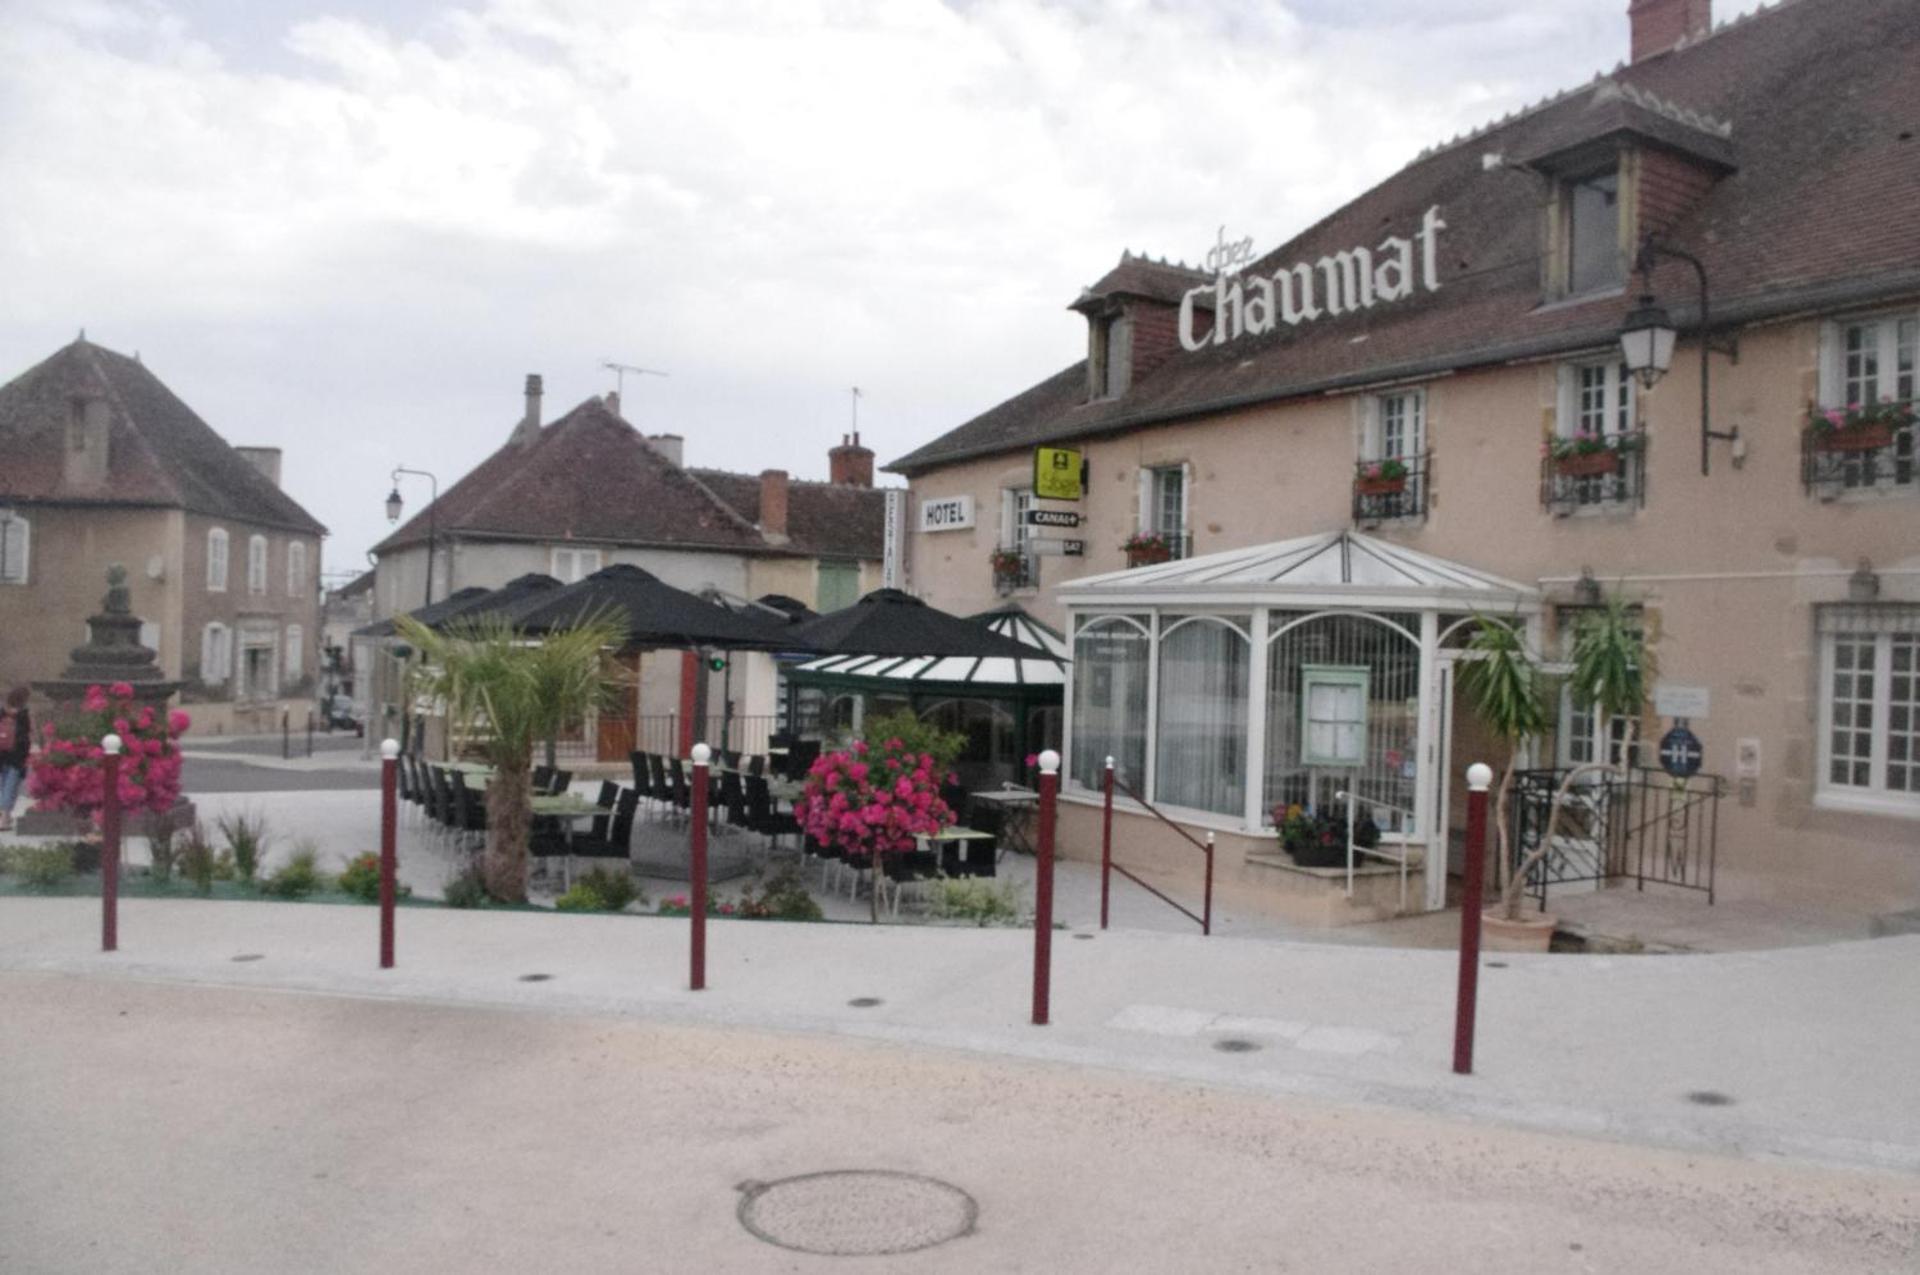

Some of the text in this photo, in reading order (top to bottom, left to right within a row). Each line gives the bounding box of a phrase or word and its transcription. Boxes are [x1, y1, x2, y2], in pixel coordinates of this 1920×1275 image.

[1178, 204, 1447, 351] Chaumat
[926, 502, 965, 525] HOTEL
[1034, 512, 1077, 526] CANAL+
